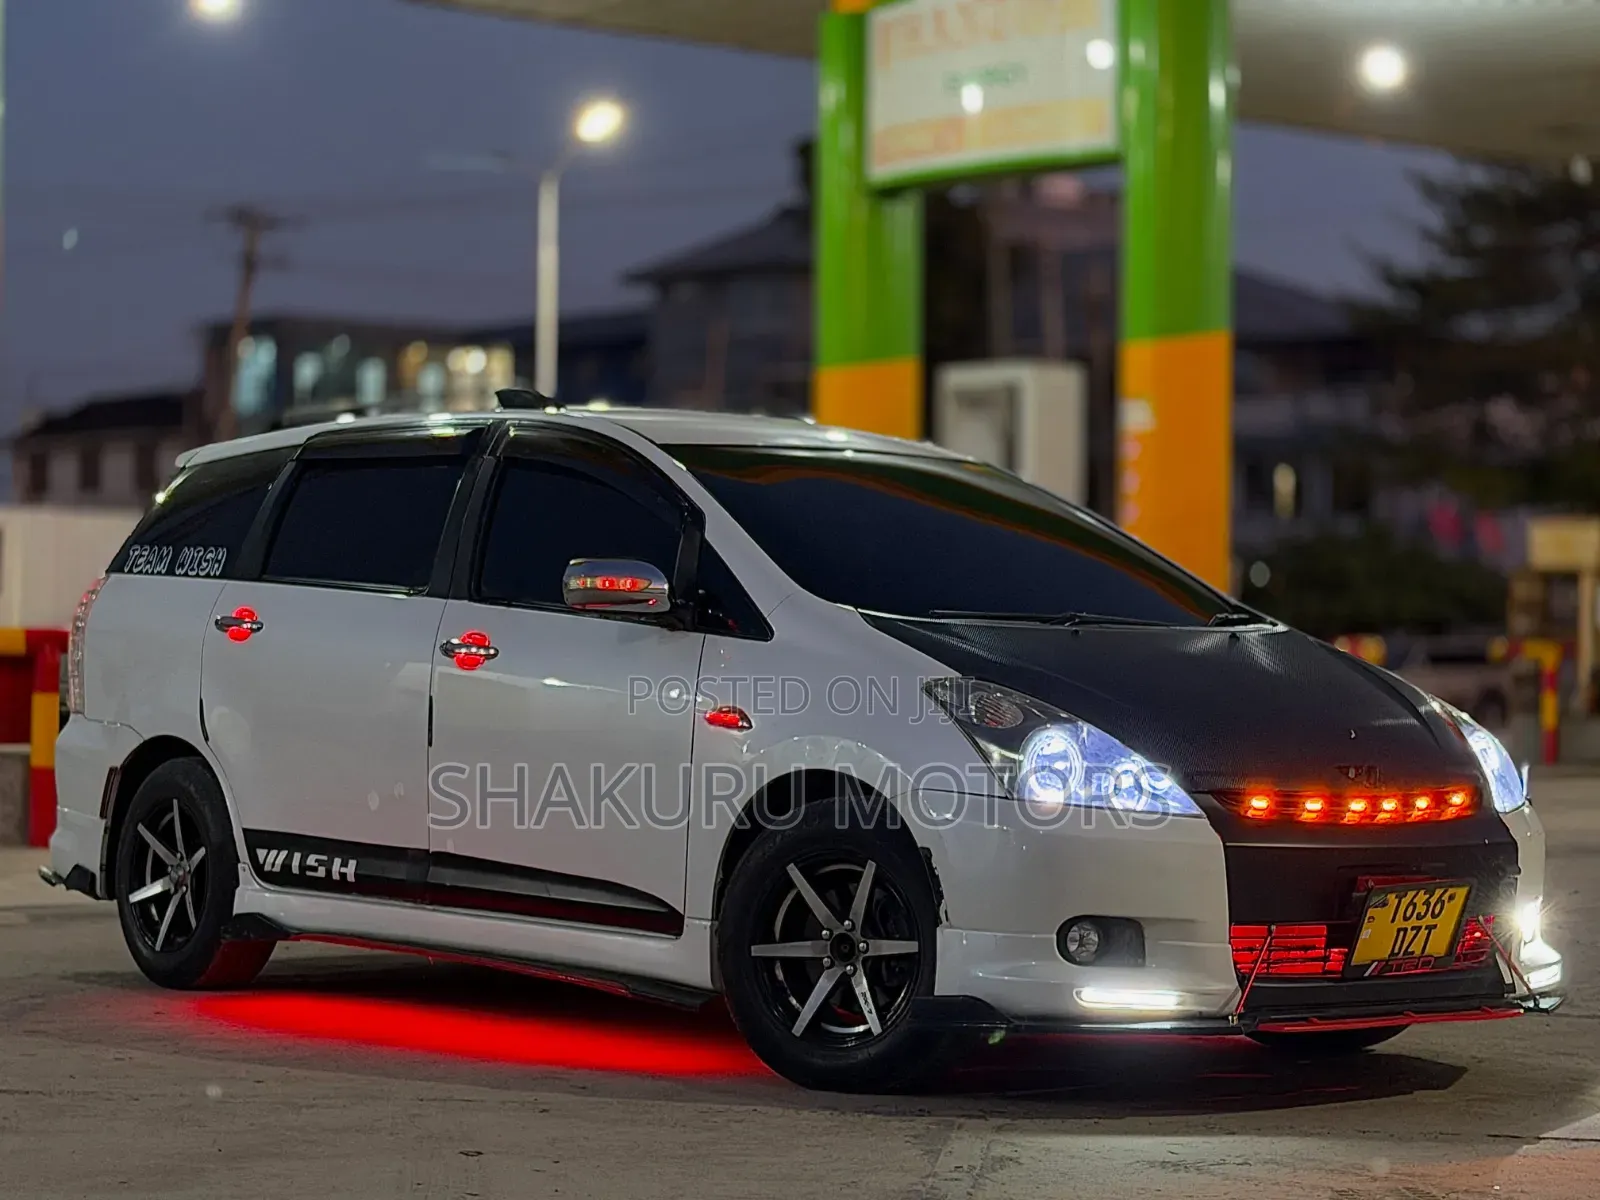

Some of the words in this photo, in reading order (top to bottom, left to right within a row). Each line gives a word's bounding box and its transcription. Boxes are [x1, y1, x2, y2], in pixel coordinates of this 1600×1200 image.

[124, 544, 172, 575] TEAM
[175, 546, 227, 576] WISH
[255, 848, 357, 883] WISH
[1390, 887, 1450, 924] T636
[1389, 924, 1438, 957] DZT
